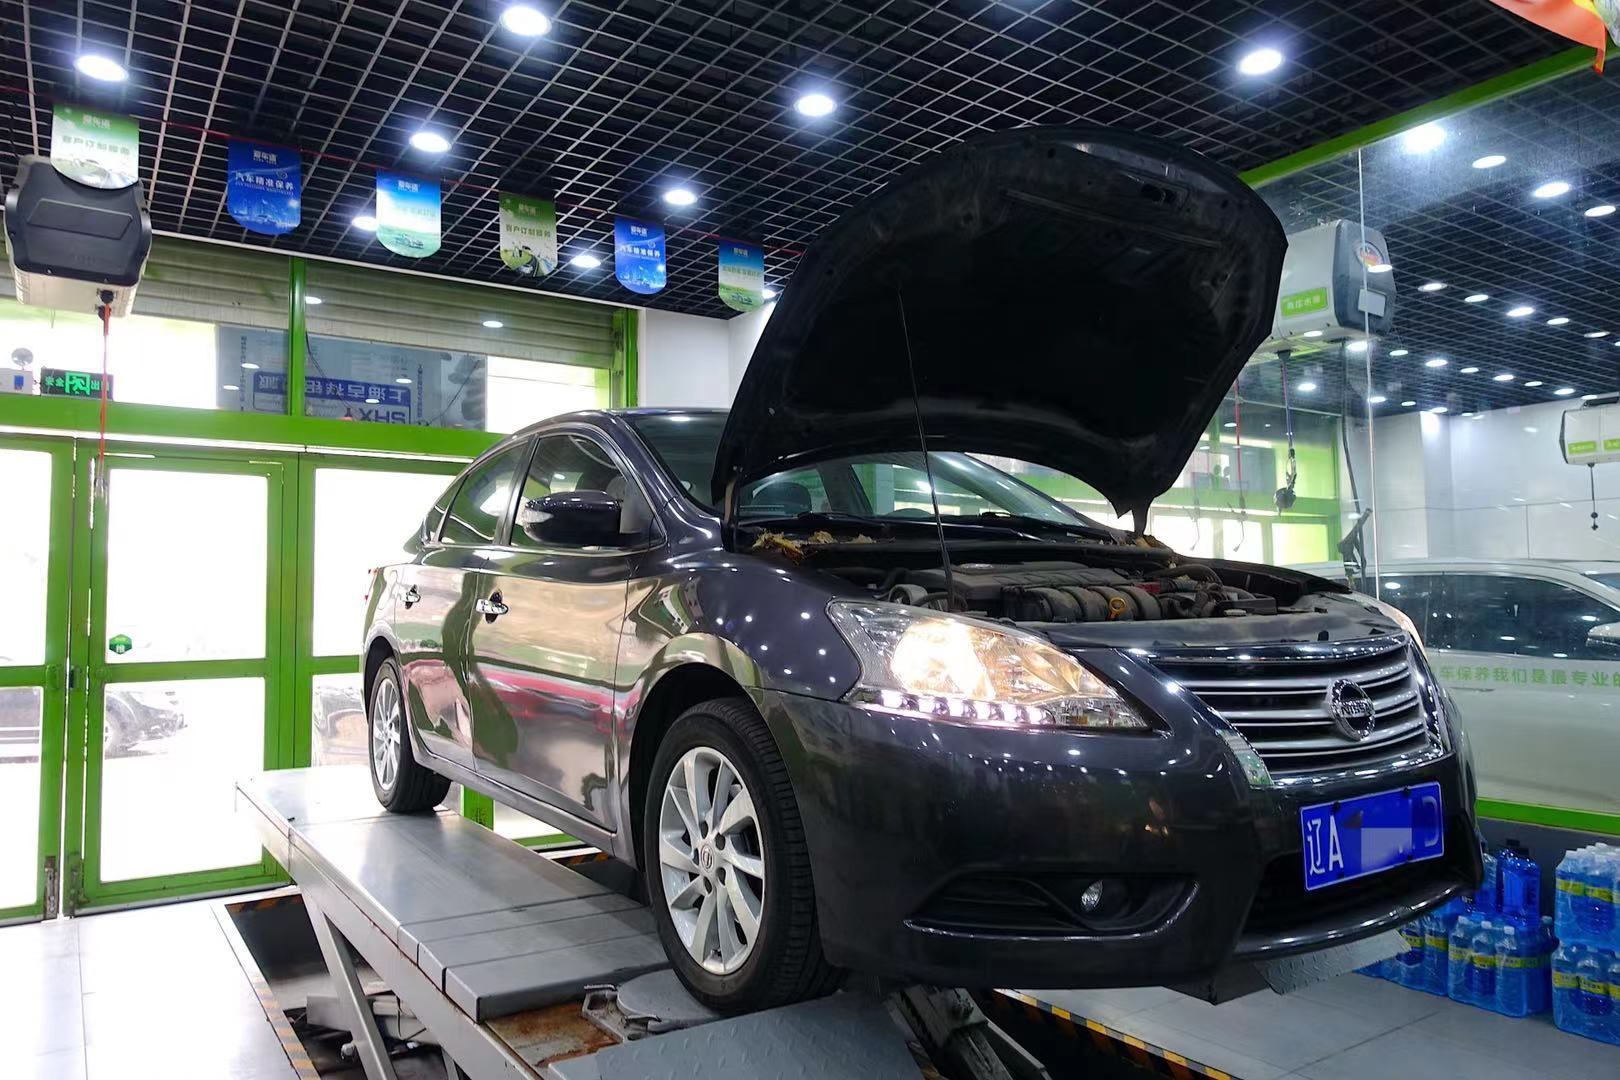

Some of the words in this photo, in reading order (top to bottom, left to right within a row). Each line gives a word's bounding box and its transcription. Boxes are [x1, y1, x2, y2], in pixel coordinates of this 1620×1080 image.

[235, 171, 294, 191] 汽车精准保养
[45, 376, 65, 388] 安全
[1433, 665, 1620, 688] 车保养我们是最专业
